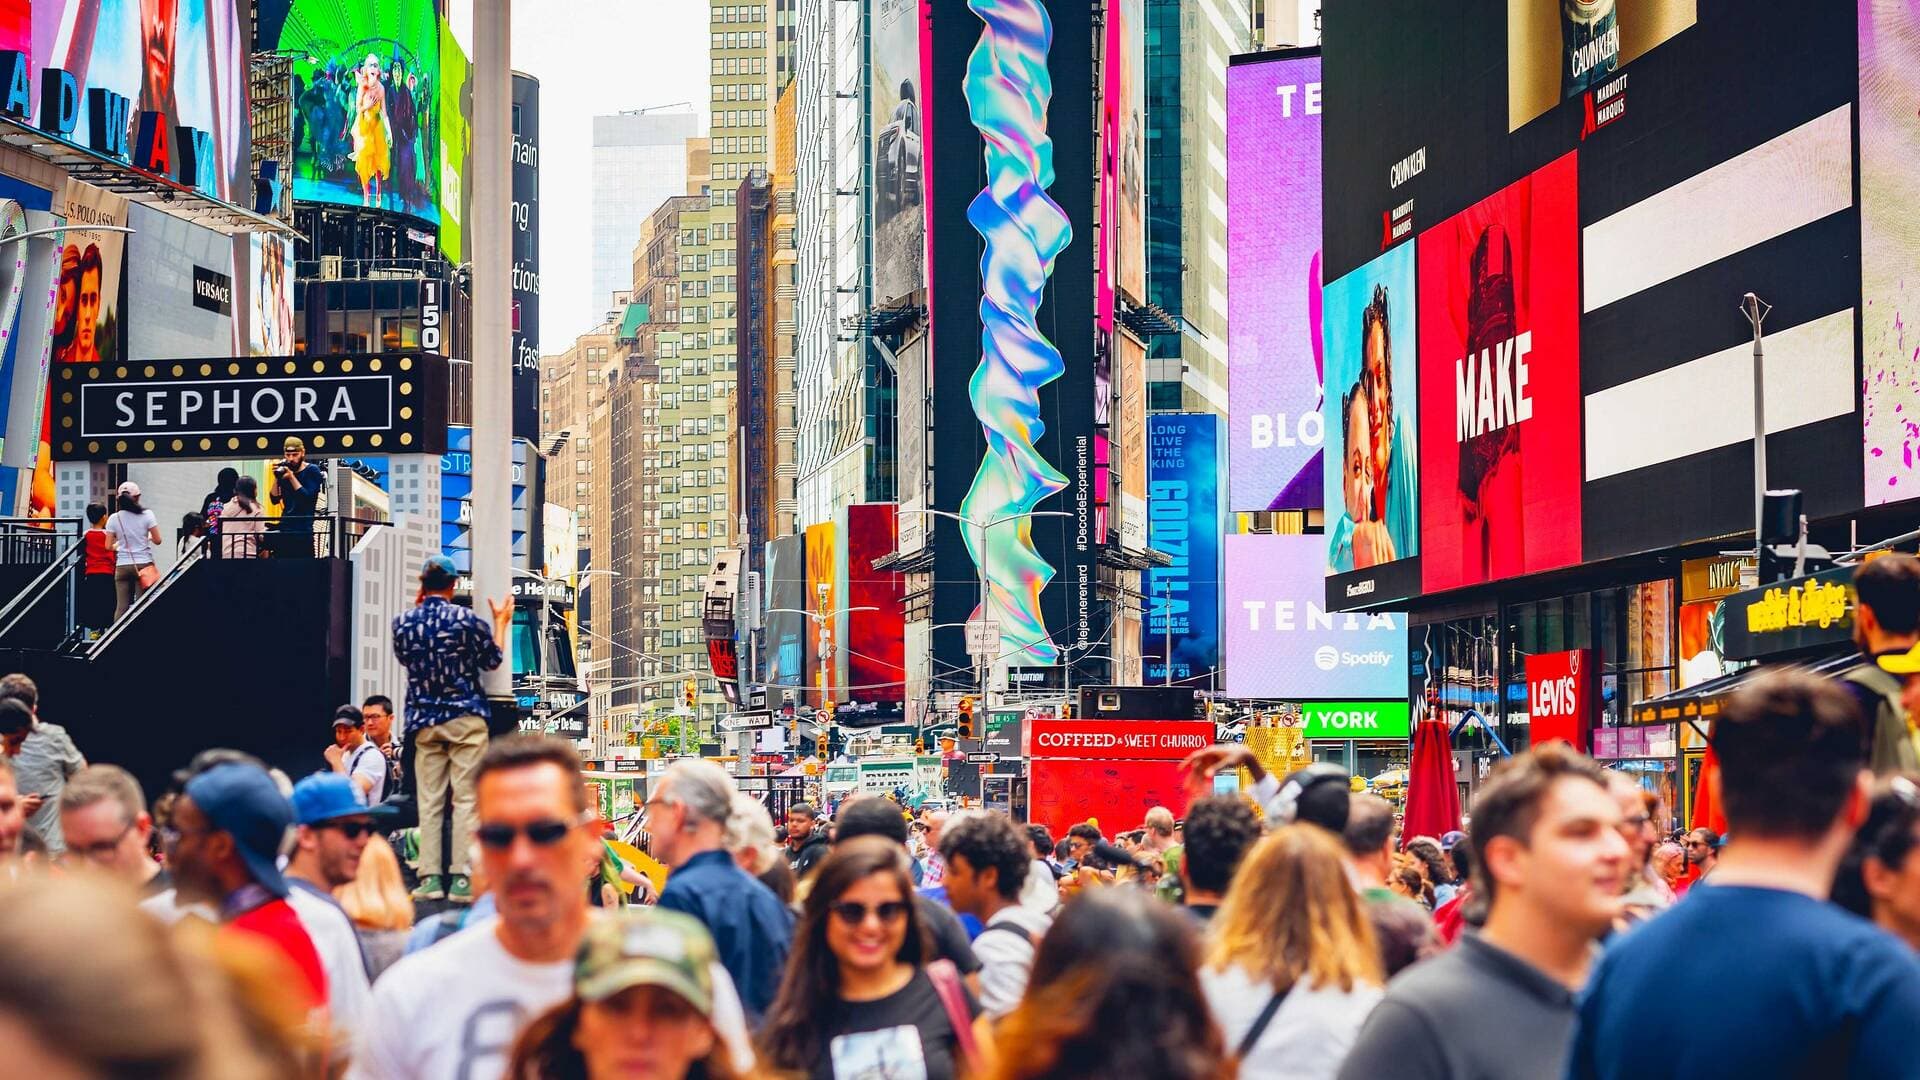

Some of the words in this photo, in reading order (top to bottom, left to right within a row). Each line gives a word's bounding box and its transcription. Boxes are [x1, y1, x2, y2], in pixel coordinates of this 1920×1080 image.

[1572, 38, 1599, 78] CALVIN
[1598, 25, 1620, 60] KLEIN
[1597, 73, 1628, 104] MARRIOTT
[1597, 98, 1625, 125] MARQUIS
[1390, 156, 1411, 190] CALVIN
[1409, 146, 1426, 178] KLEIN
[76, 203, 96, 225] POLO
[196, 279, 230, 304] VERSACE
[1456, 330, 1533, 443] MAKE
[115, 386, 357, 428] SEPHORA
[1151, 425, 1187, 436] LONG
[1153, 437, 1183, 447] LIVE
[1156, 448, 1182, 458] THE
[1152, 459, 1186, 469] KING
[1076, 435, 1088, 551] #DecodeExperiential
[1149, 479, 1190, 618] GODZILLA
[1077, 564, 1089, 650] @lejeunerenard
[1150, 617, 1178, 627] KING
[1342, 651, 1393, 667] Spotify
[1011, 673, 1044, 682] TRADITION
[1178, 669, 1190, 678] 31
[748, 716, 766, 725] WAY
[1317, 711, 1380, 729] YORK
[1038, 733, 1116, 747] COFFEED
[1124, 734, 1157, 748] SWEET
[1160, 734, 1207, 749] CHURROS
[1479, 758, 1491, 779] BIG
